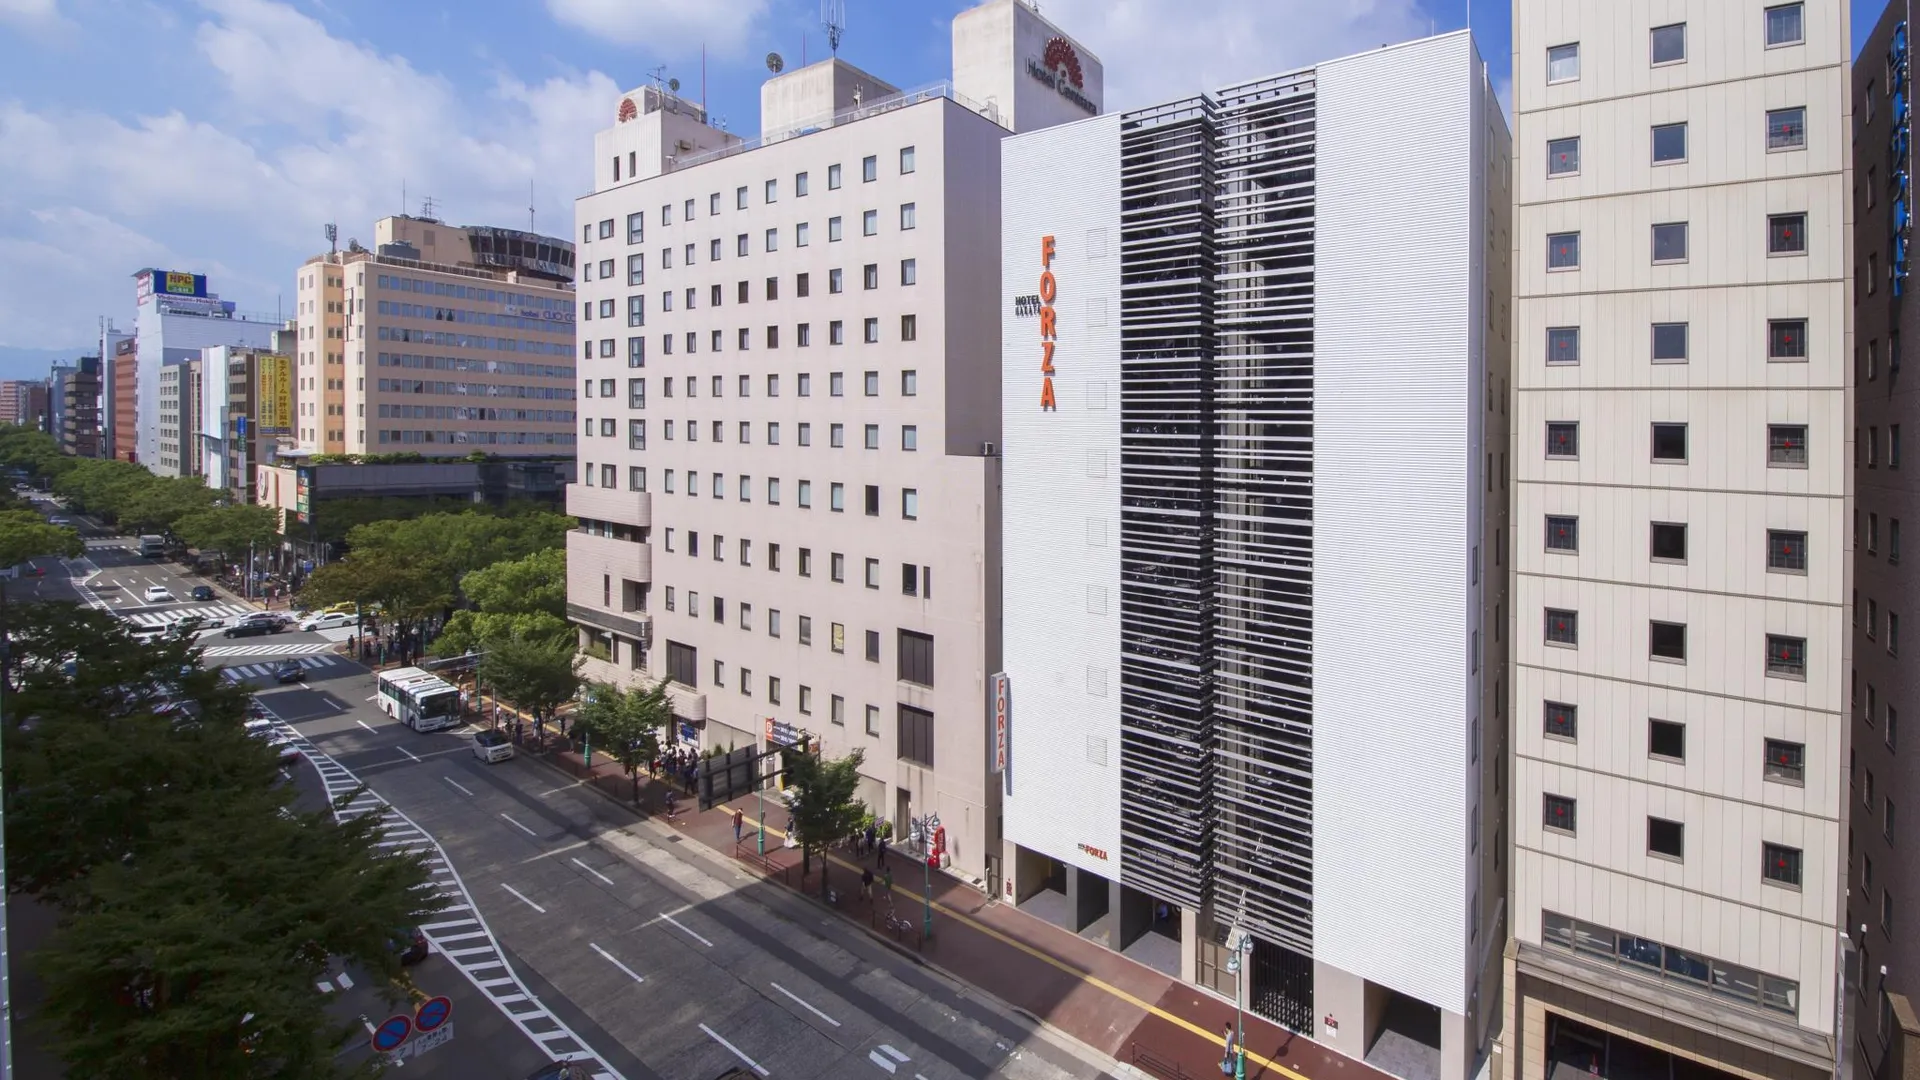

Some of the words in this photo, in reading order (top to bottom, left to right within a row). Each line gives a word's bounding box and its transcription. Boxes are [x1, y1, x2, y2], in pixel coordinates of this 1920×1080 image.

[1026, 57, 1056, 89] Hotel
[1015, 294, 1041, 306] HOTEL
[1040, 236, 1056, 409] FORZA
[997, 679, 1005, 767] FORZA
[1085, 845, 1107, 860] FORZA
